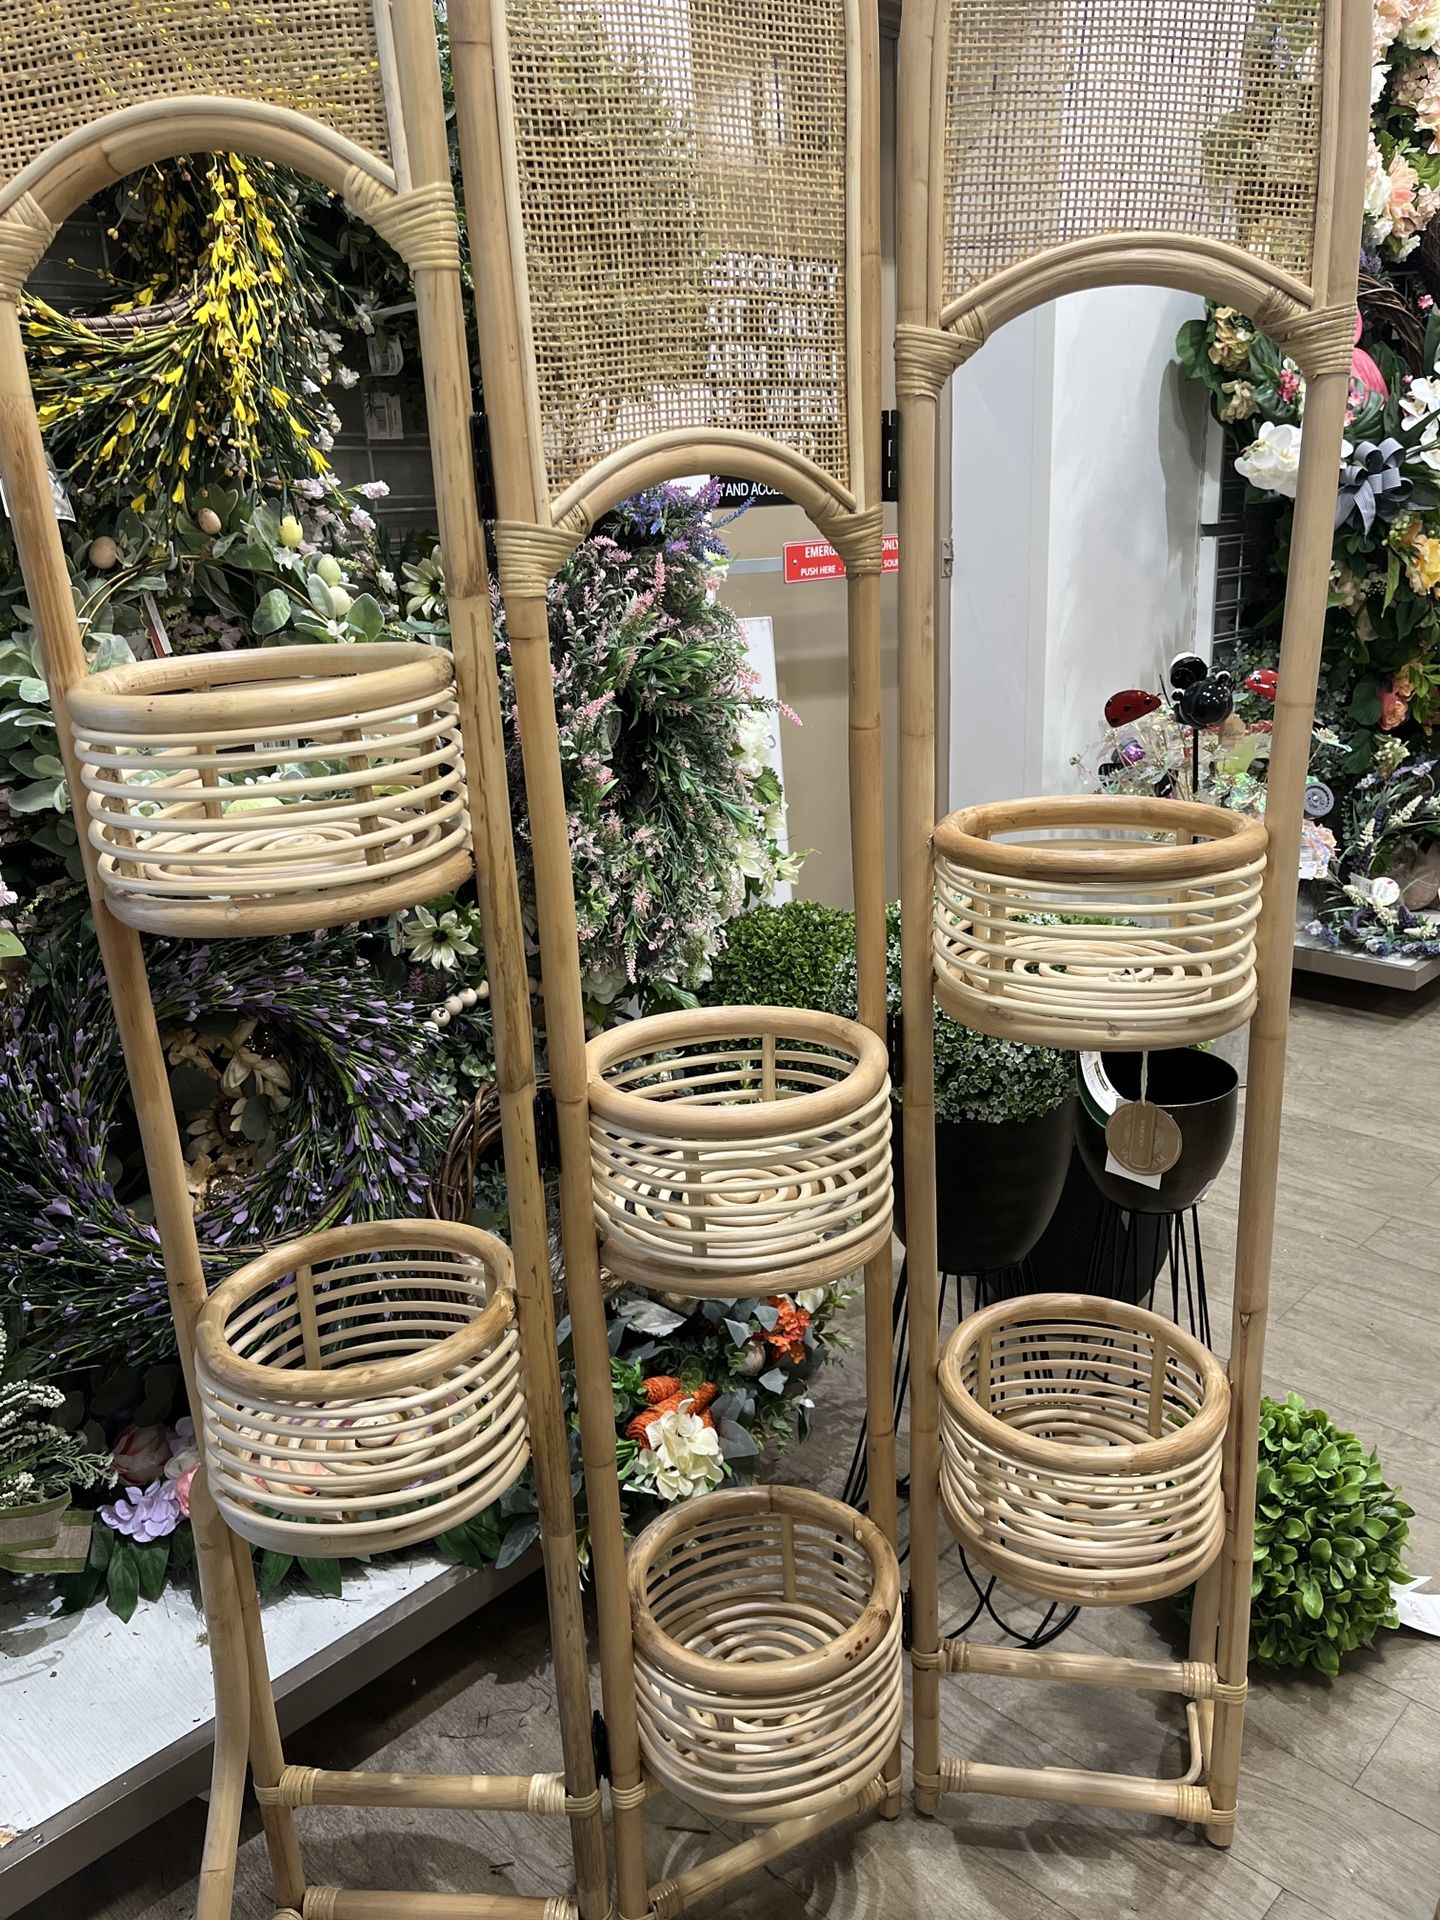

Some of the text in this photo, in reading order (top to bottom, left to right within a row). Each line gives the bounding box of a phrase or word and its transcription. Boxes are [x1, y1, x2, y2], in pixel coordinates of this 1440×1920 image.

[725, 482, 749, 497] AND
[751, 482, 784, 496] ACC
[805, 545, 838, 558] EMERG
[800, 567, 818, 576] PUSH
[820, 565, 836, 574] HERE
